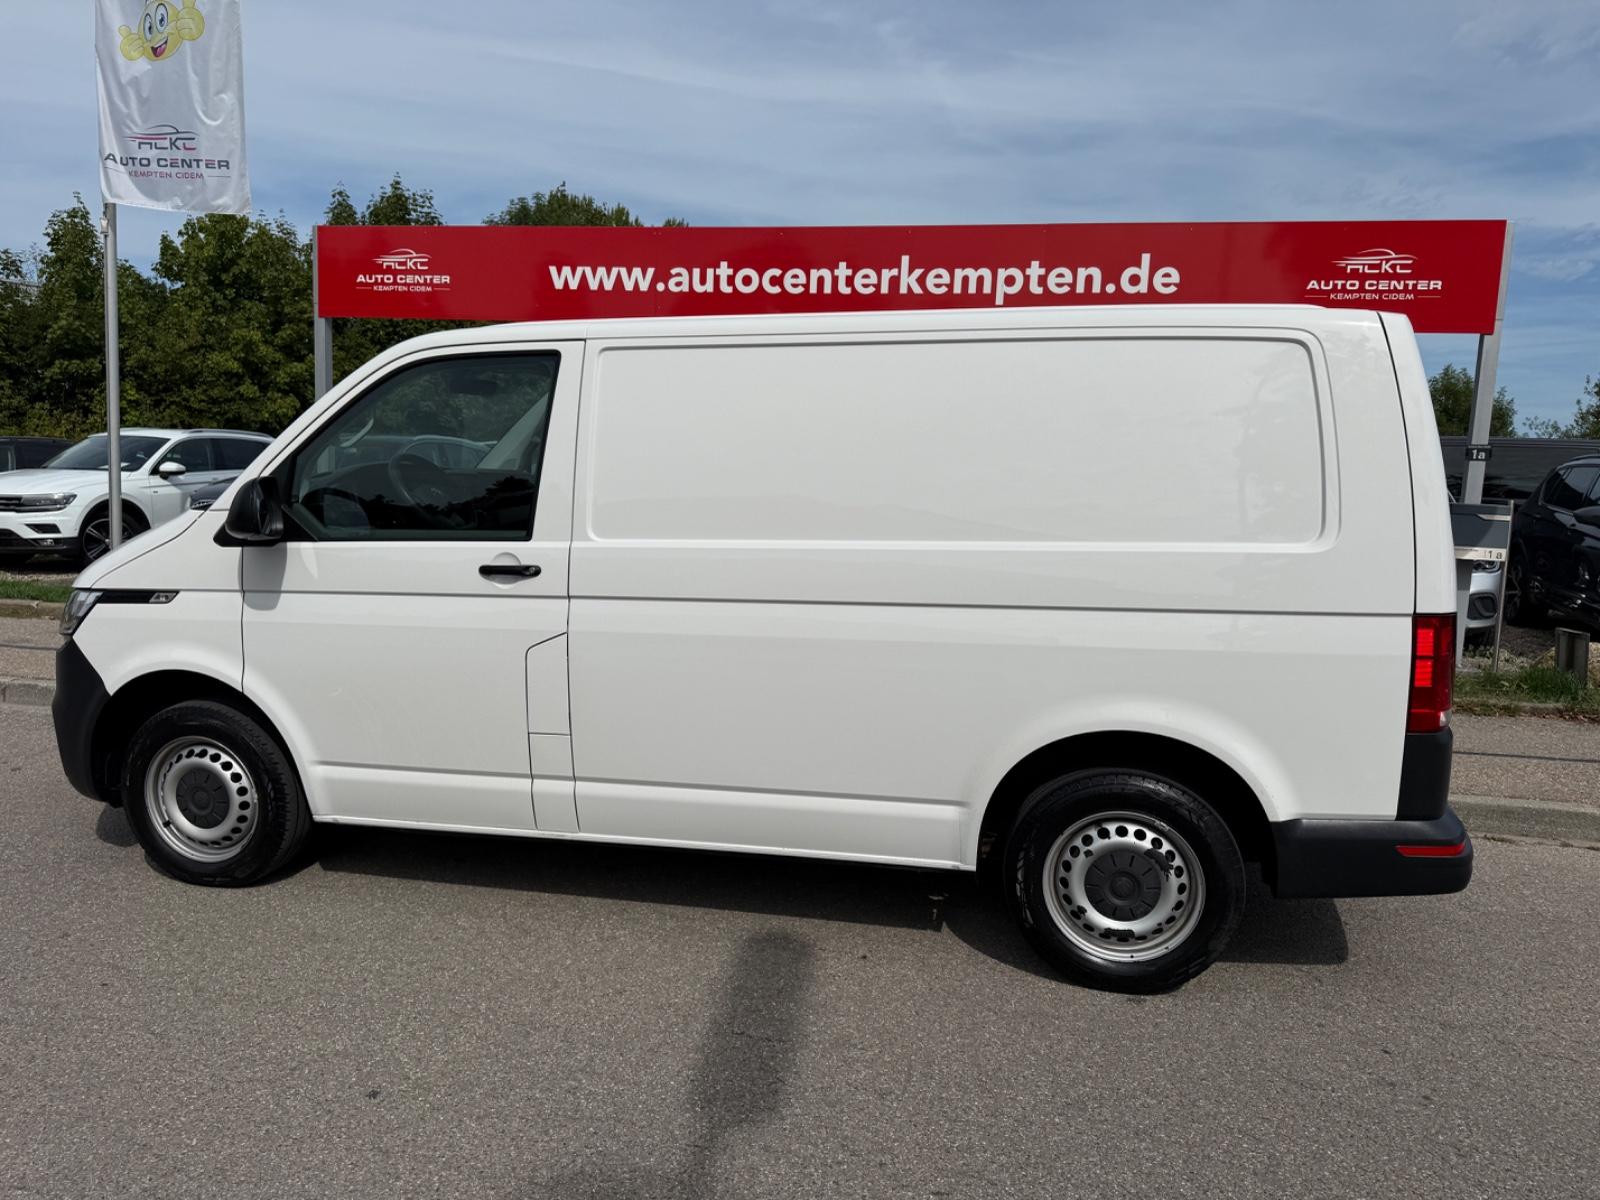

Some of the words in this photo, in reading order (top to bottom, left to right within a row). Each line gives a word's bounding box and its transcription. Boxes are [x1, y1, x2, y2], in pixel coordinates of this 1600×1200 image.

[104, 153, 151, 168] AUTO
[156, 157, 230, 170] CENTER
[128, 170, 172, 179] KEMPTEN
[175, 172, 204, 180] CIDEM
[356, 274, 394, 284] AUTO
[396, 274, 451, 285] CENTER
[548, 253, 1181, 306] www.autocenterkempten.de
[1306, 280, 1360, 290] AUTO
[1364, 280, 1443, 290] CENTER
[1472, 449, 1486, 460] 1a
